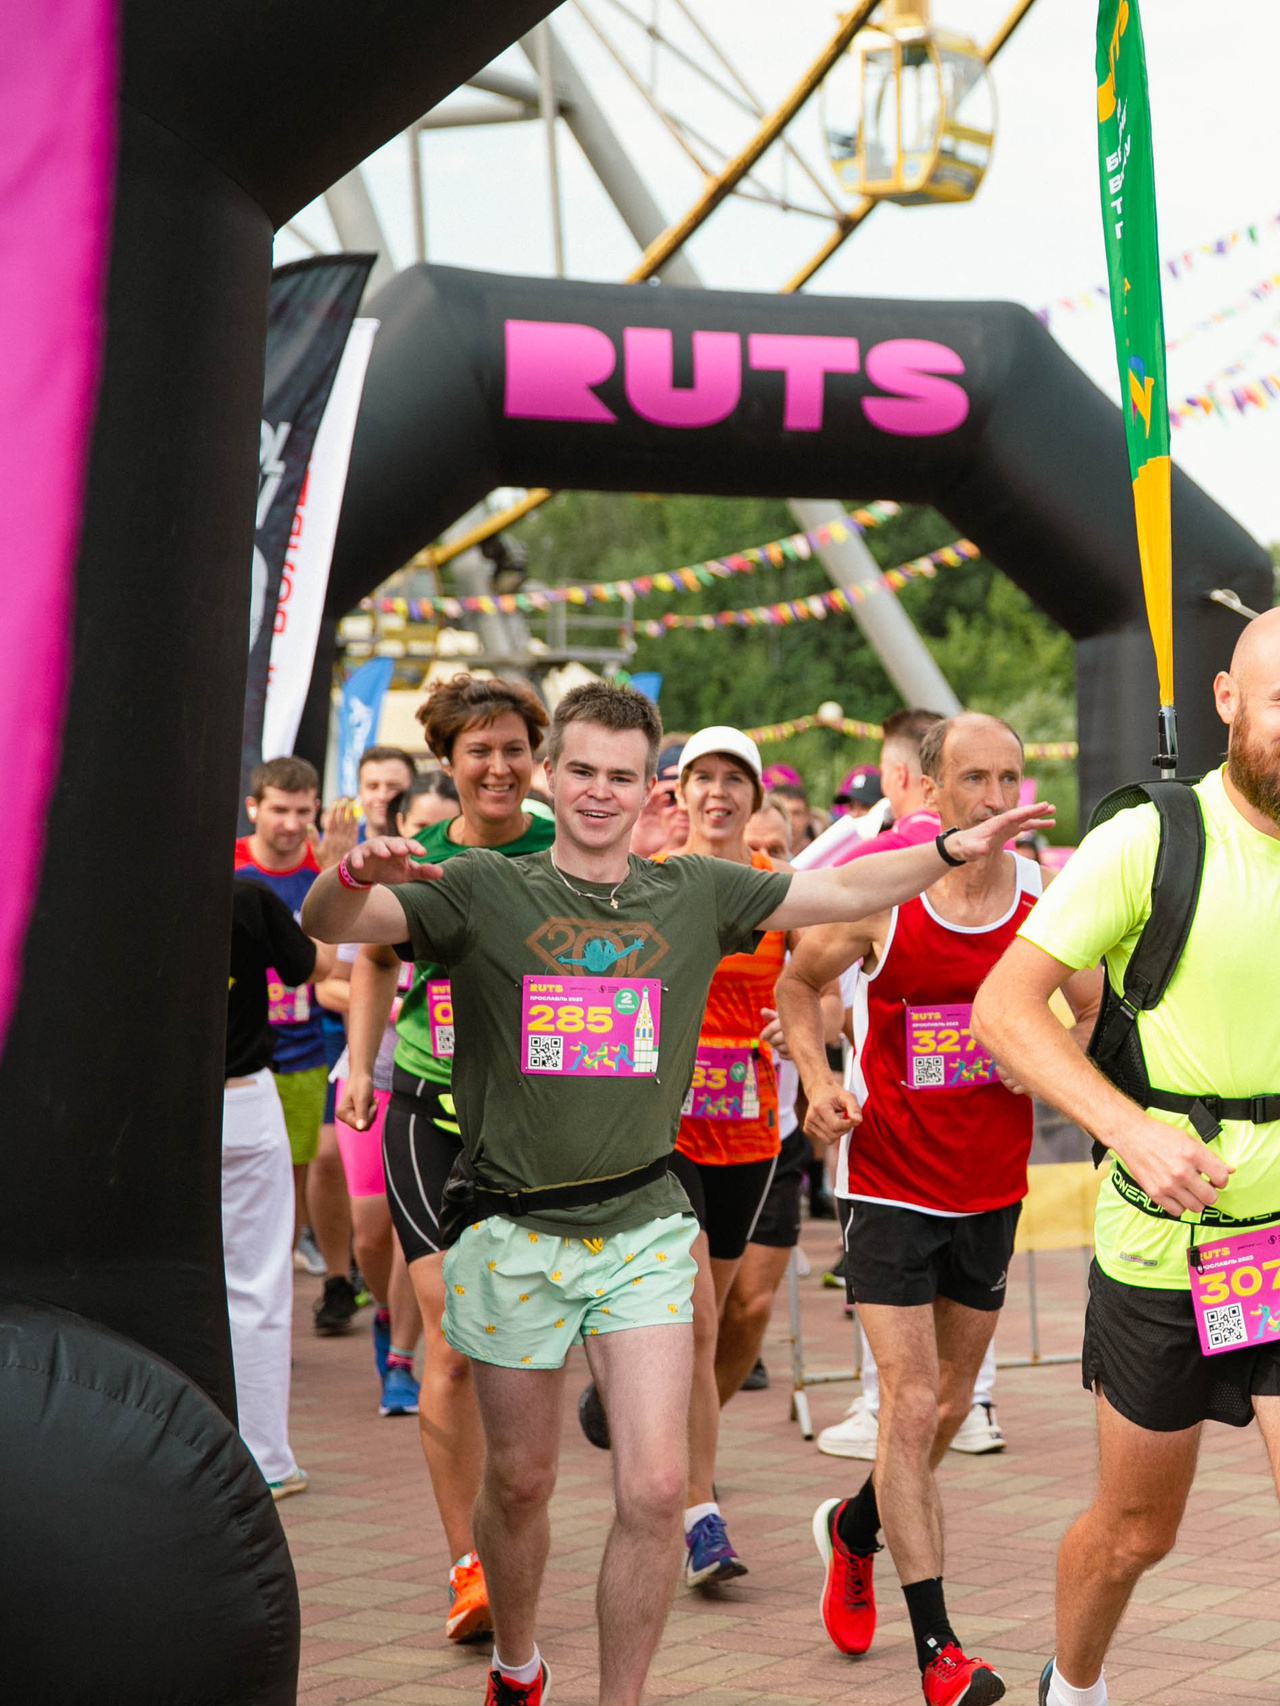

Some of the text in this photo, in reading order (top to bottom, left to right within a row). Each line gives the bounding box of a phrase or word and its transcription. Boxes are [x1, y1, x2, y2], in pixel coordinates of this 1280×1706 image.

[504, 319, 969, 437] RUTS
[530, 984, 564, 993] RUTS
[620, 991, 632, 1004] 2
[527, 1004, 614, 1034] 285
[912, 1028, 977, 1054] 327
[1200, 1246, 1230, 1262] UTS
